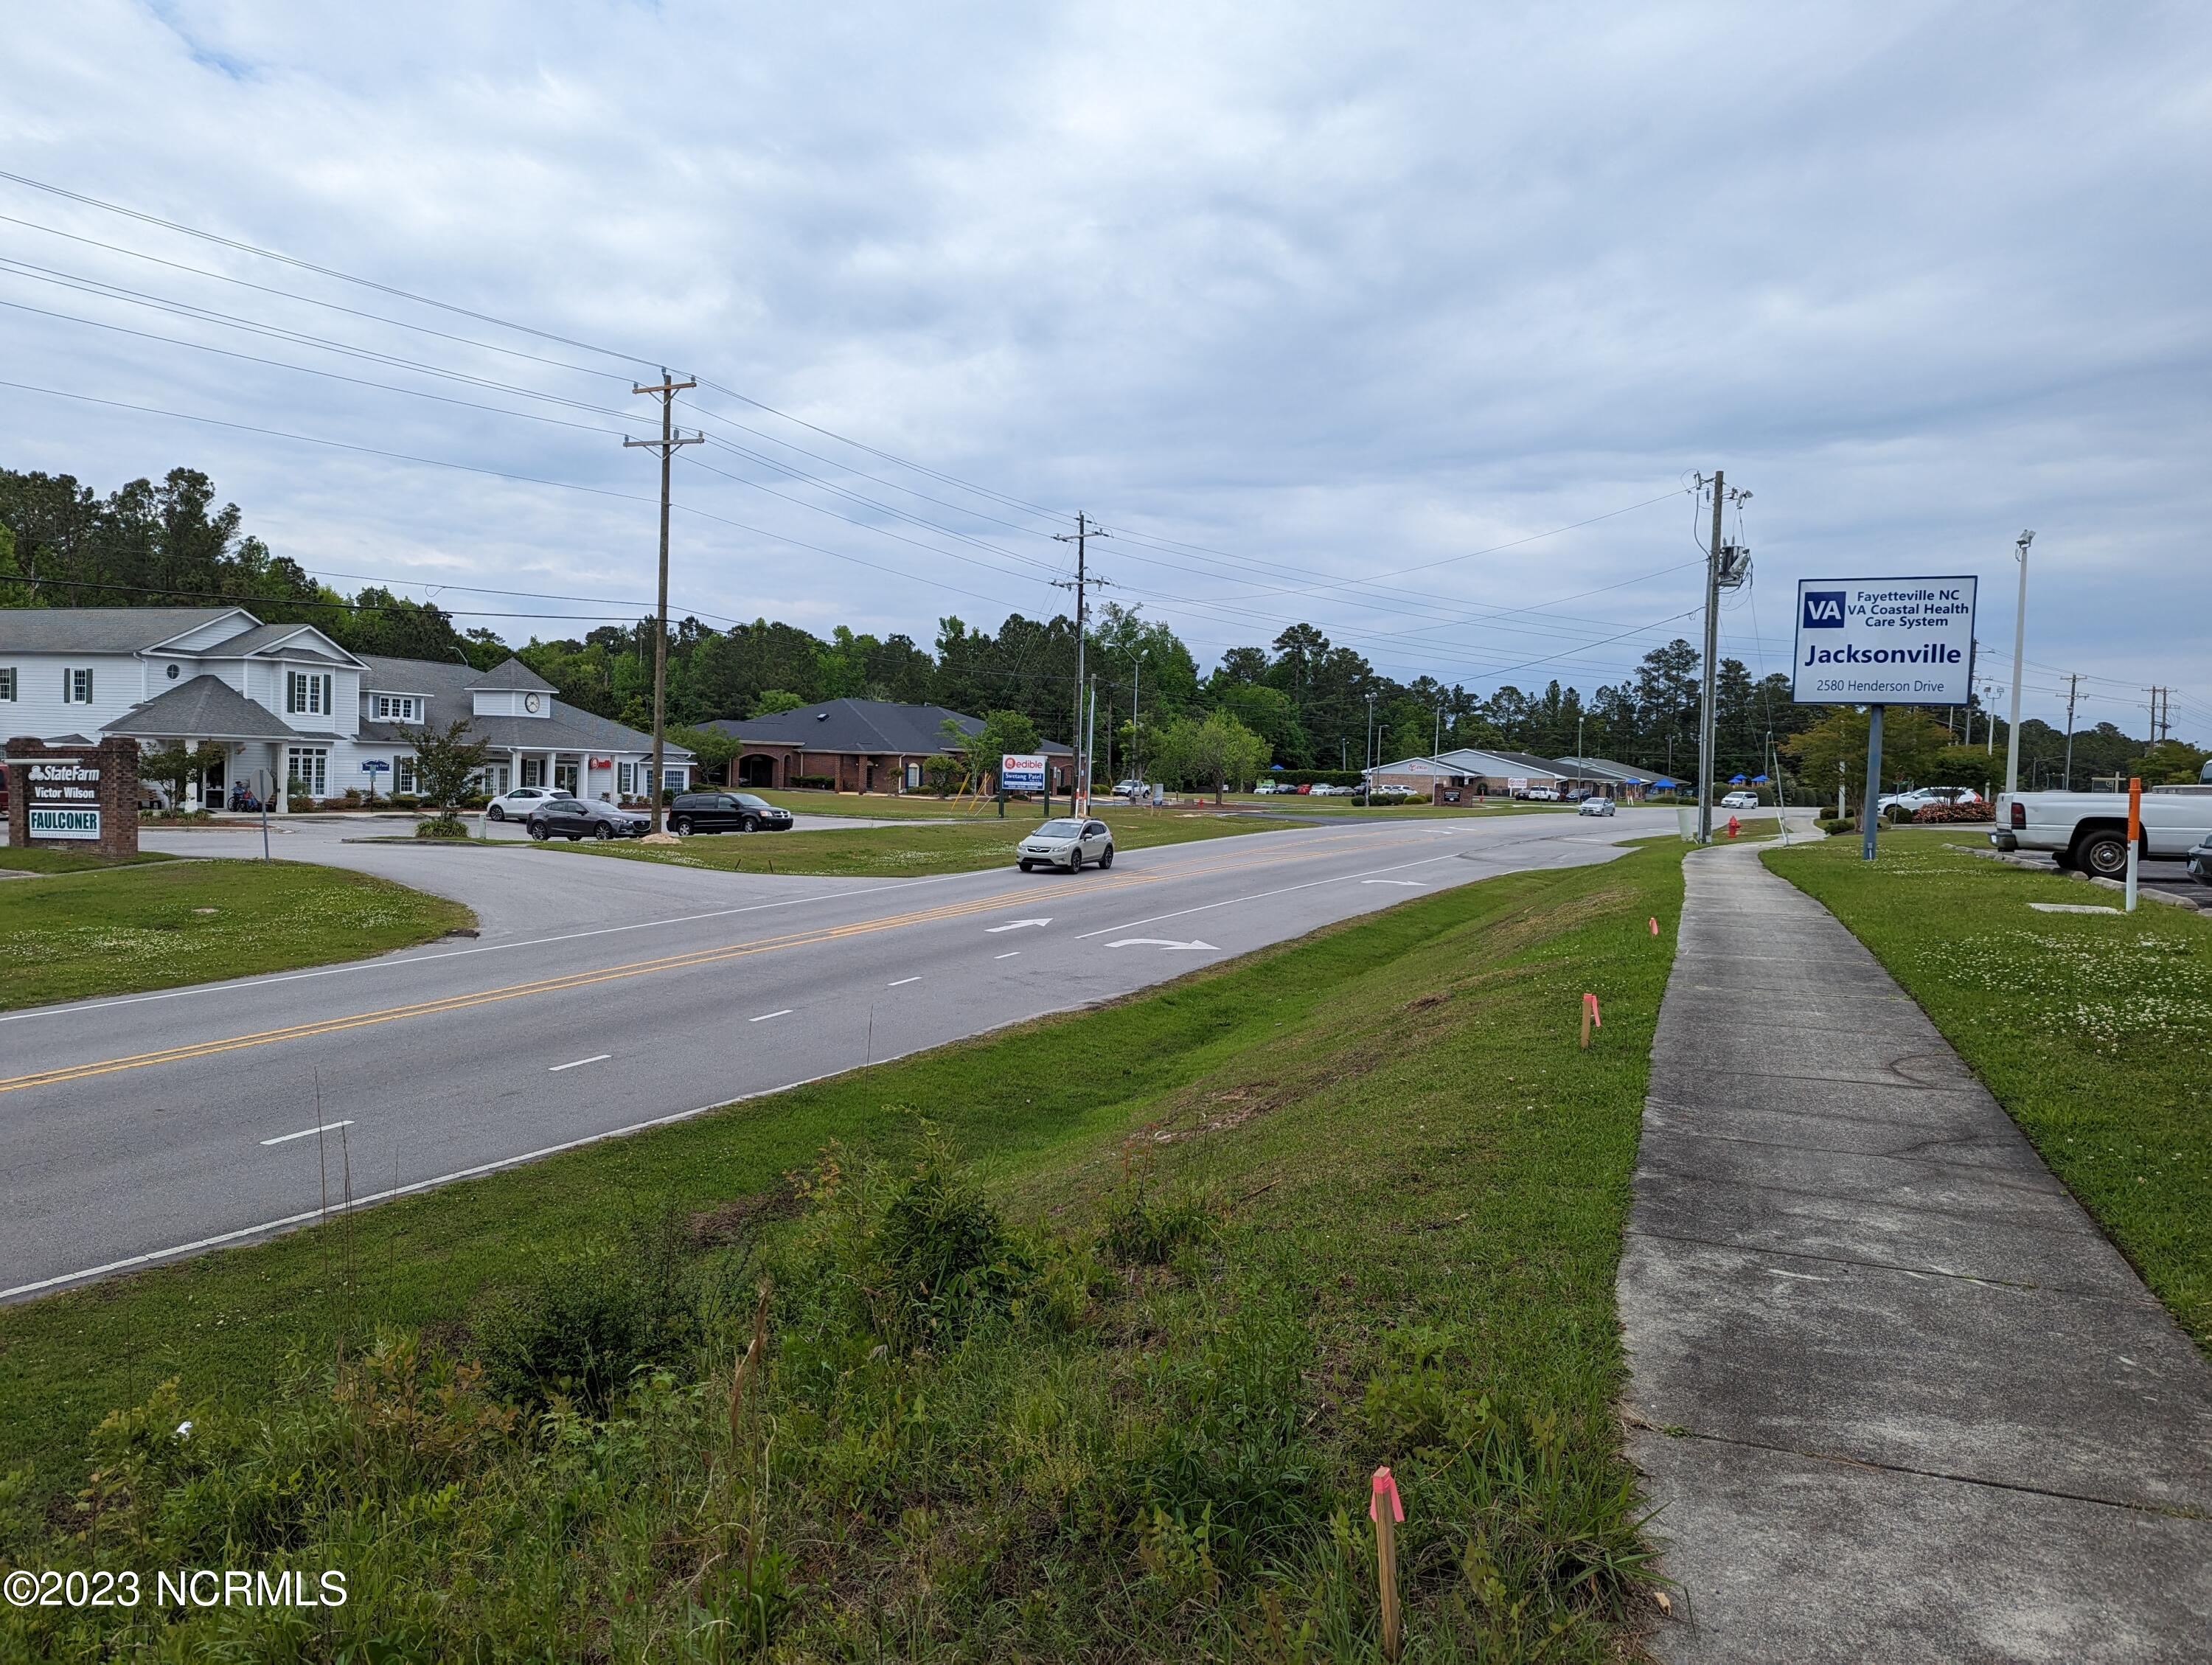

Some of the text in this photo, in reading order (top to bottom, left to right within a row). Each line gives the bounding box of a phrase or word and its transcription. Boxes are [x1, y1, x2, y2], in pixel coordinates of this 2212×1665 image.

[1857, 590, 1960, 603] Fayetteville NC
[1808, 601, 1841, 620] VA
[1848, 603, 1969, 615] VA Coastal Health
[1865, 616, 1948, 630] Care System
[1804, 644, 1961, 667] Jacksonville
[1817, 680, 1944, 692] 2580 Henderson Drive
[1016, 759, 1043, 768] edible
[35, 786, 95, 799] Victor Wilson
[31, 812, 97, 830] FAULCONER
